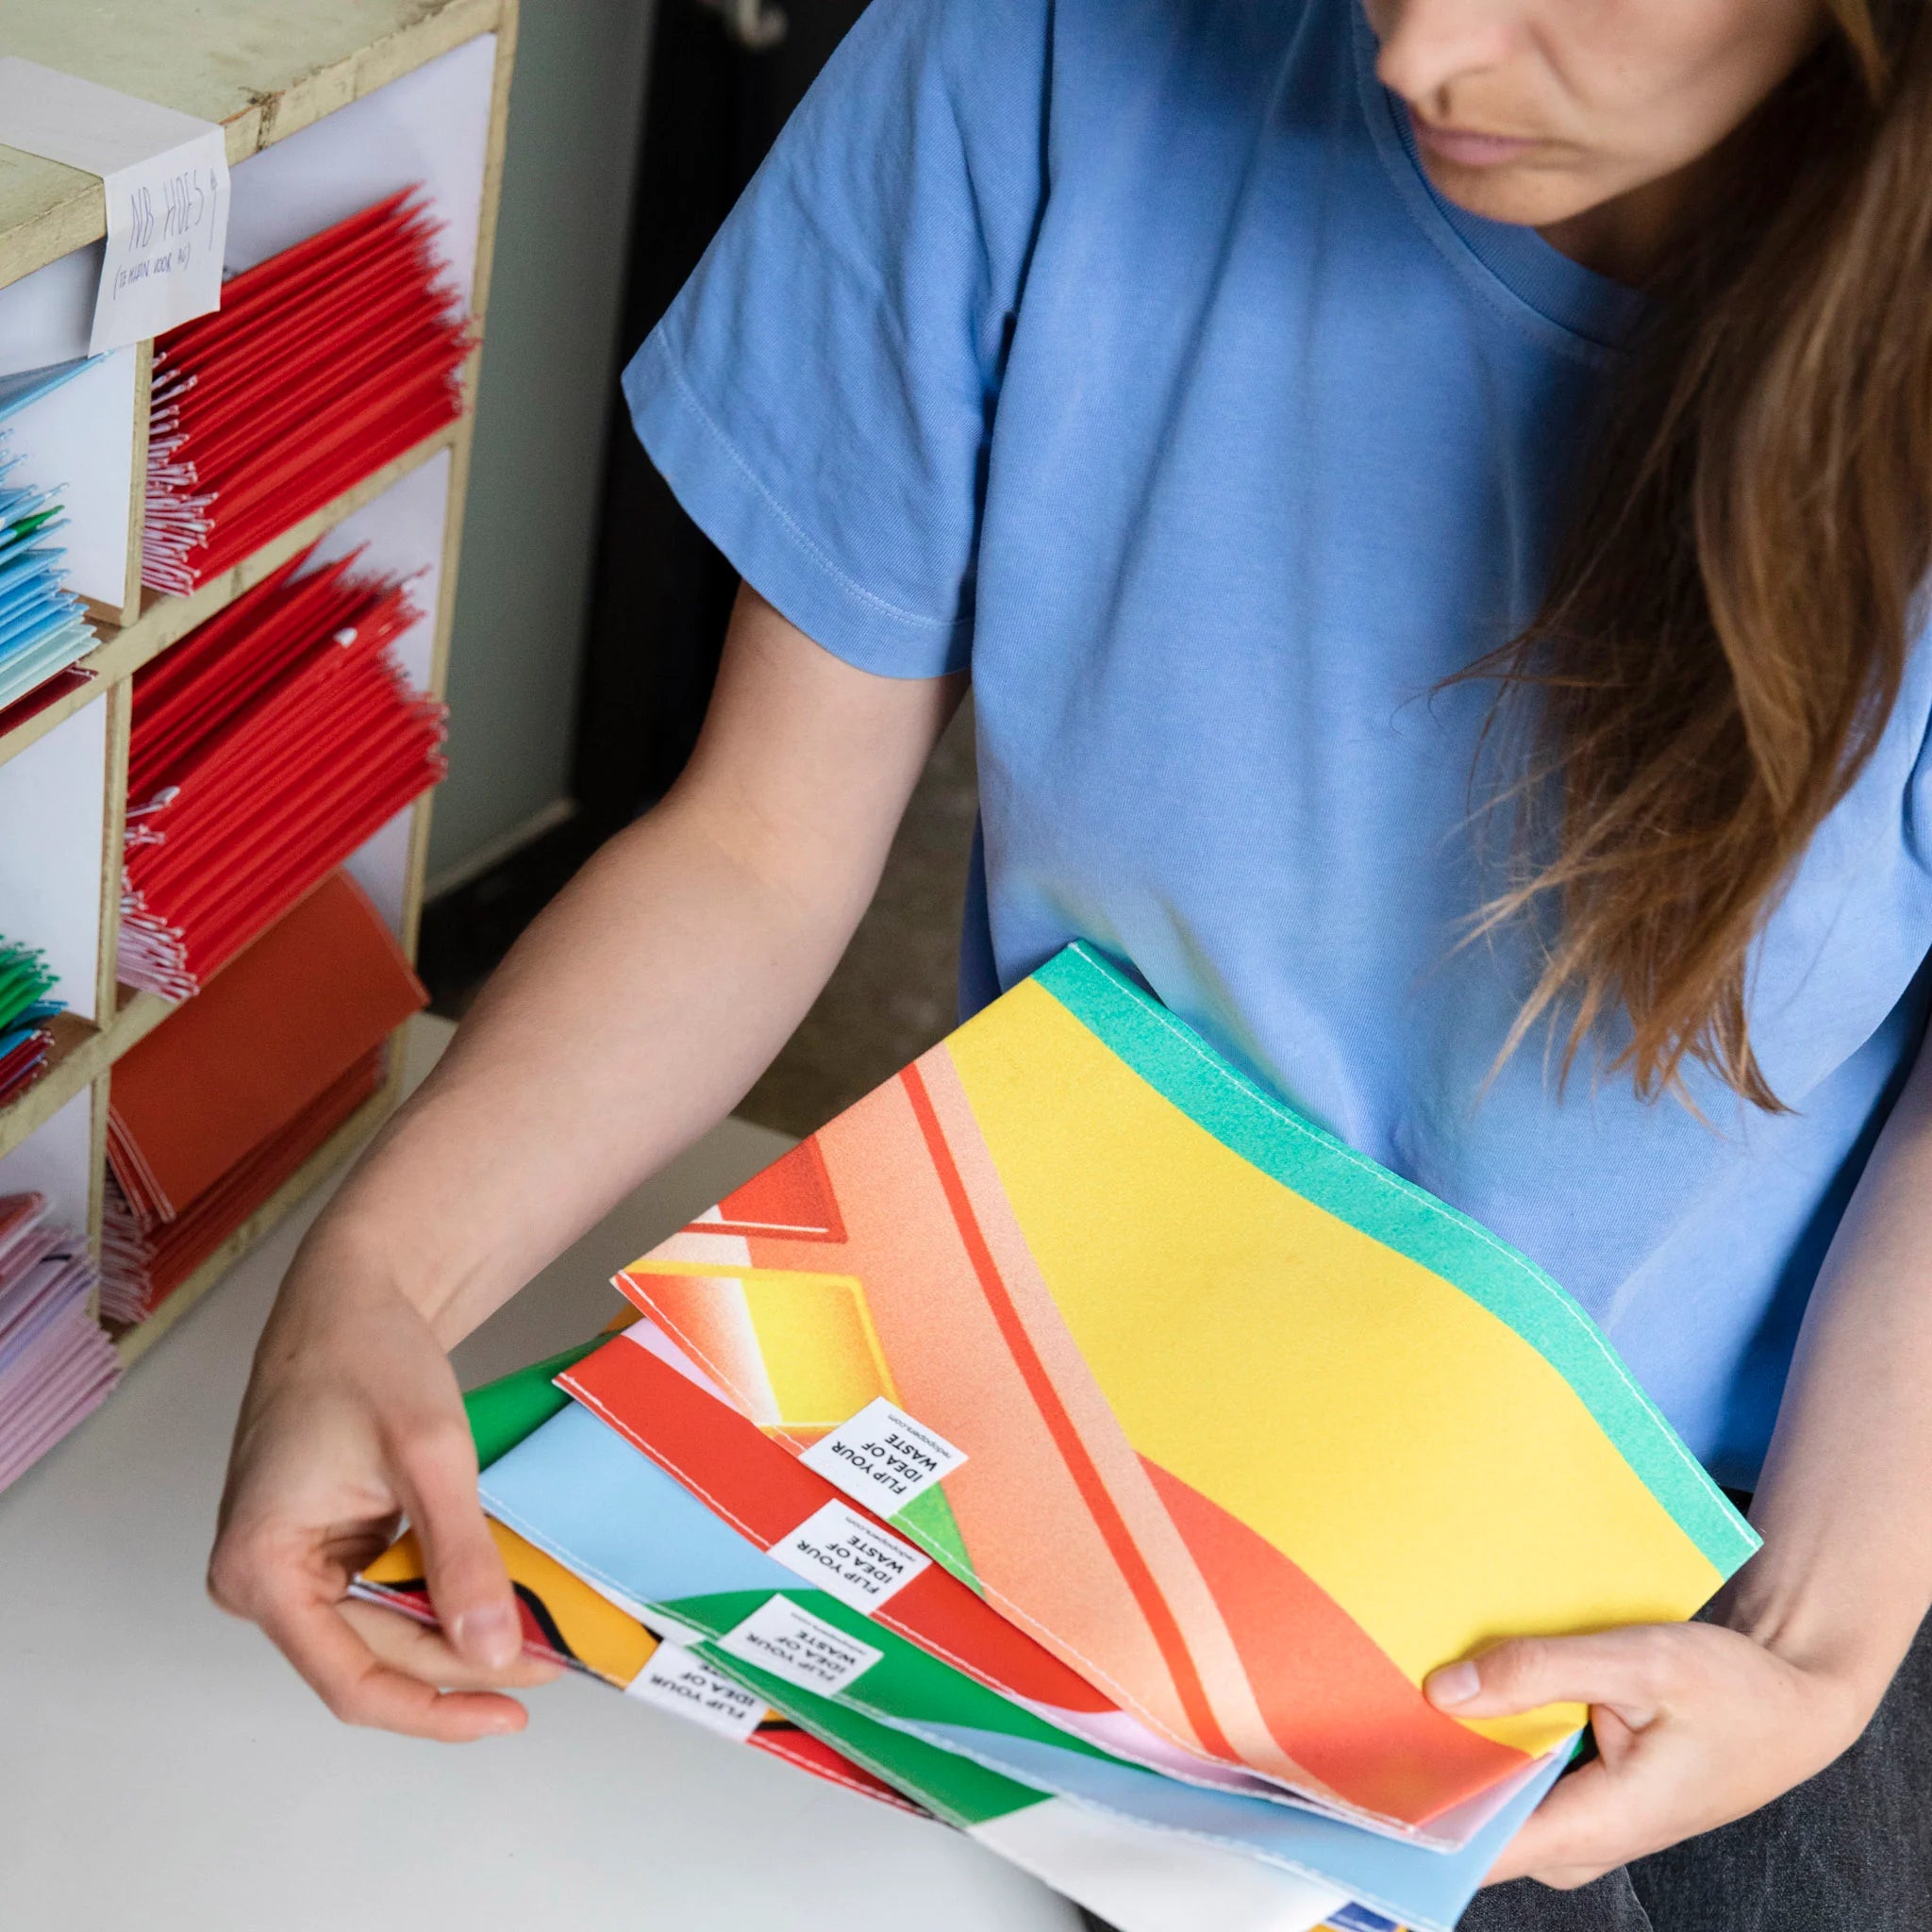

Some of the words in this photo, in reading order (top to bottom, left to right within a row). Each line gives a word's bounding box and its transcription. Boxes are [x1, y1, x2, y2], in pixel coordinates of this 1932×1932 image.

[128, 186, 155, 252] NB
[163, 169, 205, 242] HOES
[861, 1442, 885, 1457] OF
[888, 1414, 952, 1459] redopapers.com
[831, 1441, 874, 1474] YOUR
[884, 1433, 938, 1472] WASTE
[886, 1455, 924, 1483] IDEA
[873, 1472, 907, 1495] FLIP
[797, 1540, 842, 1574] YOUR
[825, 1542, 850, 1557] OF
[847, 1535, 904, 1574] WASTE
[843, 1573, 880, 1594] FLIP
[854, 1557, 892, 1584] IDEA
[746, 1632, 793, 1662] YOUR
[775, 1637, 801, 1651] OF
[796, 1630, 856, 1665] WASTE
[798, 1661, 836, 1681] FLIP
[806, 1650, 846, 1674] IDEA
[650, 1674, 703, 1703] YOUR
[679, 1672, 707, 1687] OF
[711, 1682, 756, 1707] IDEA
[706, 1700, 746, 1720] FLIP
